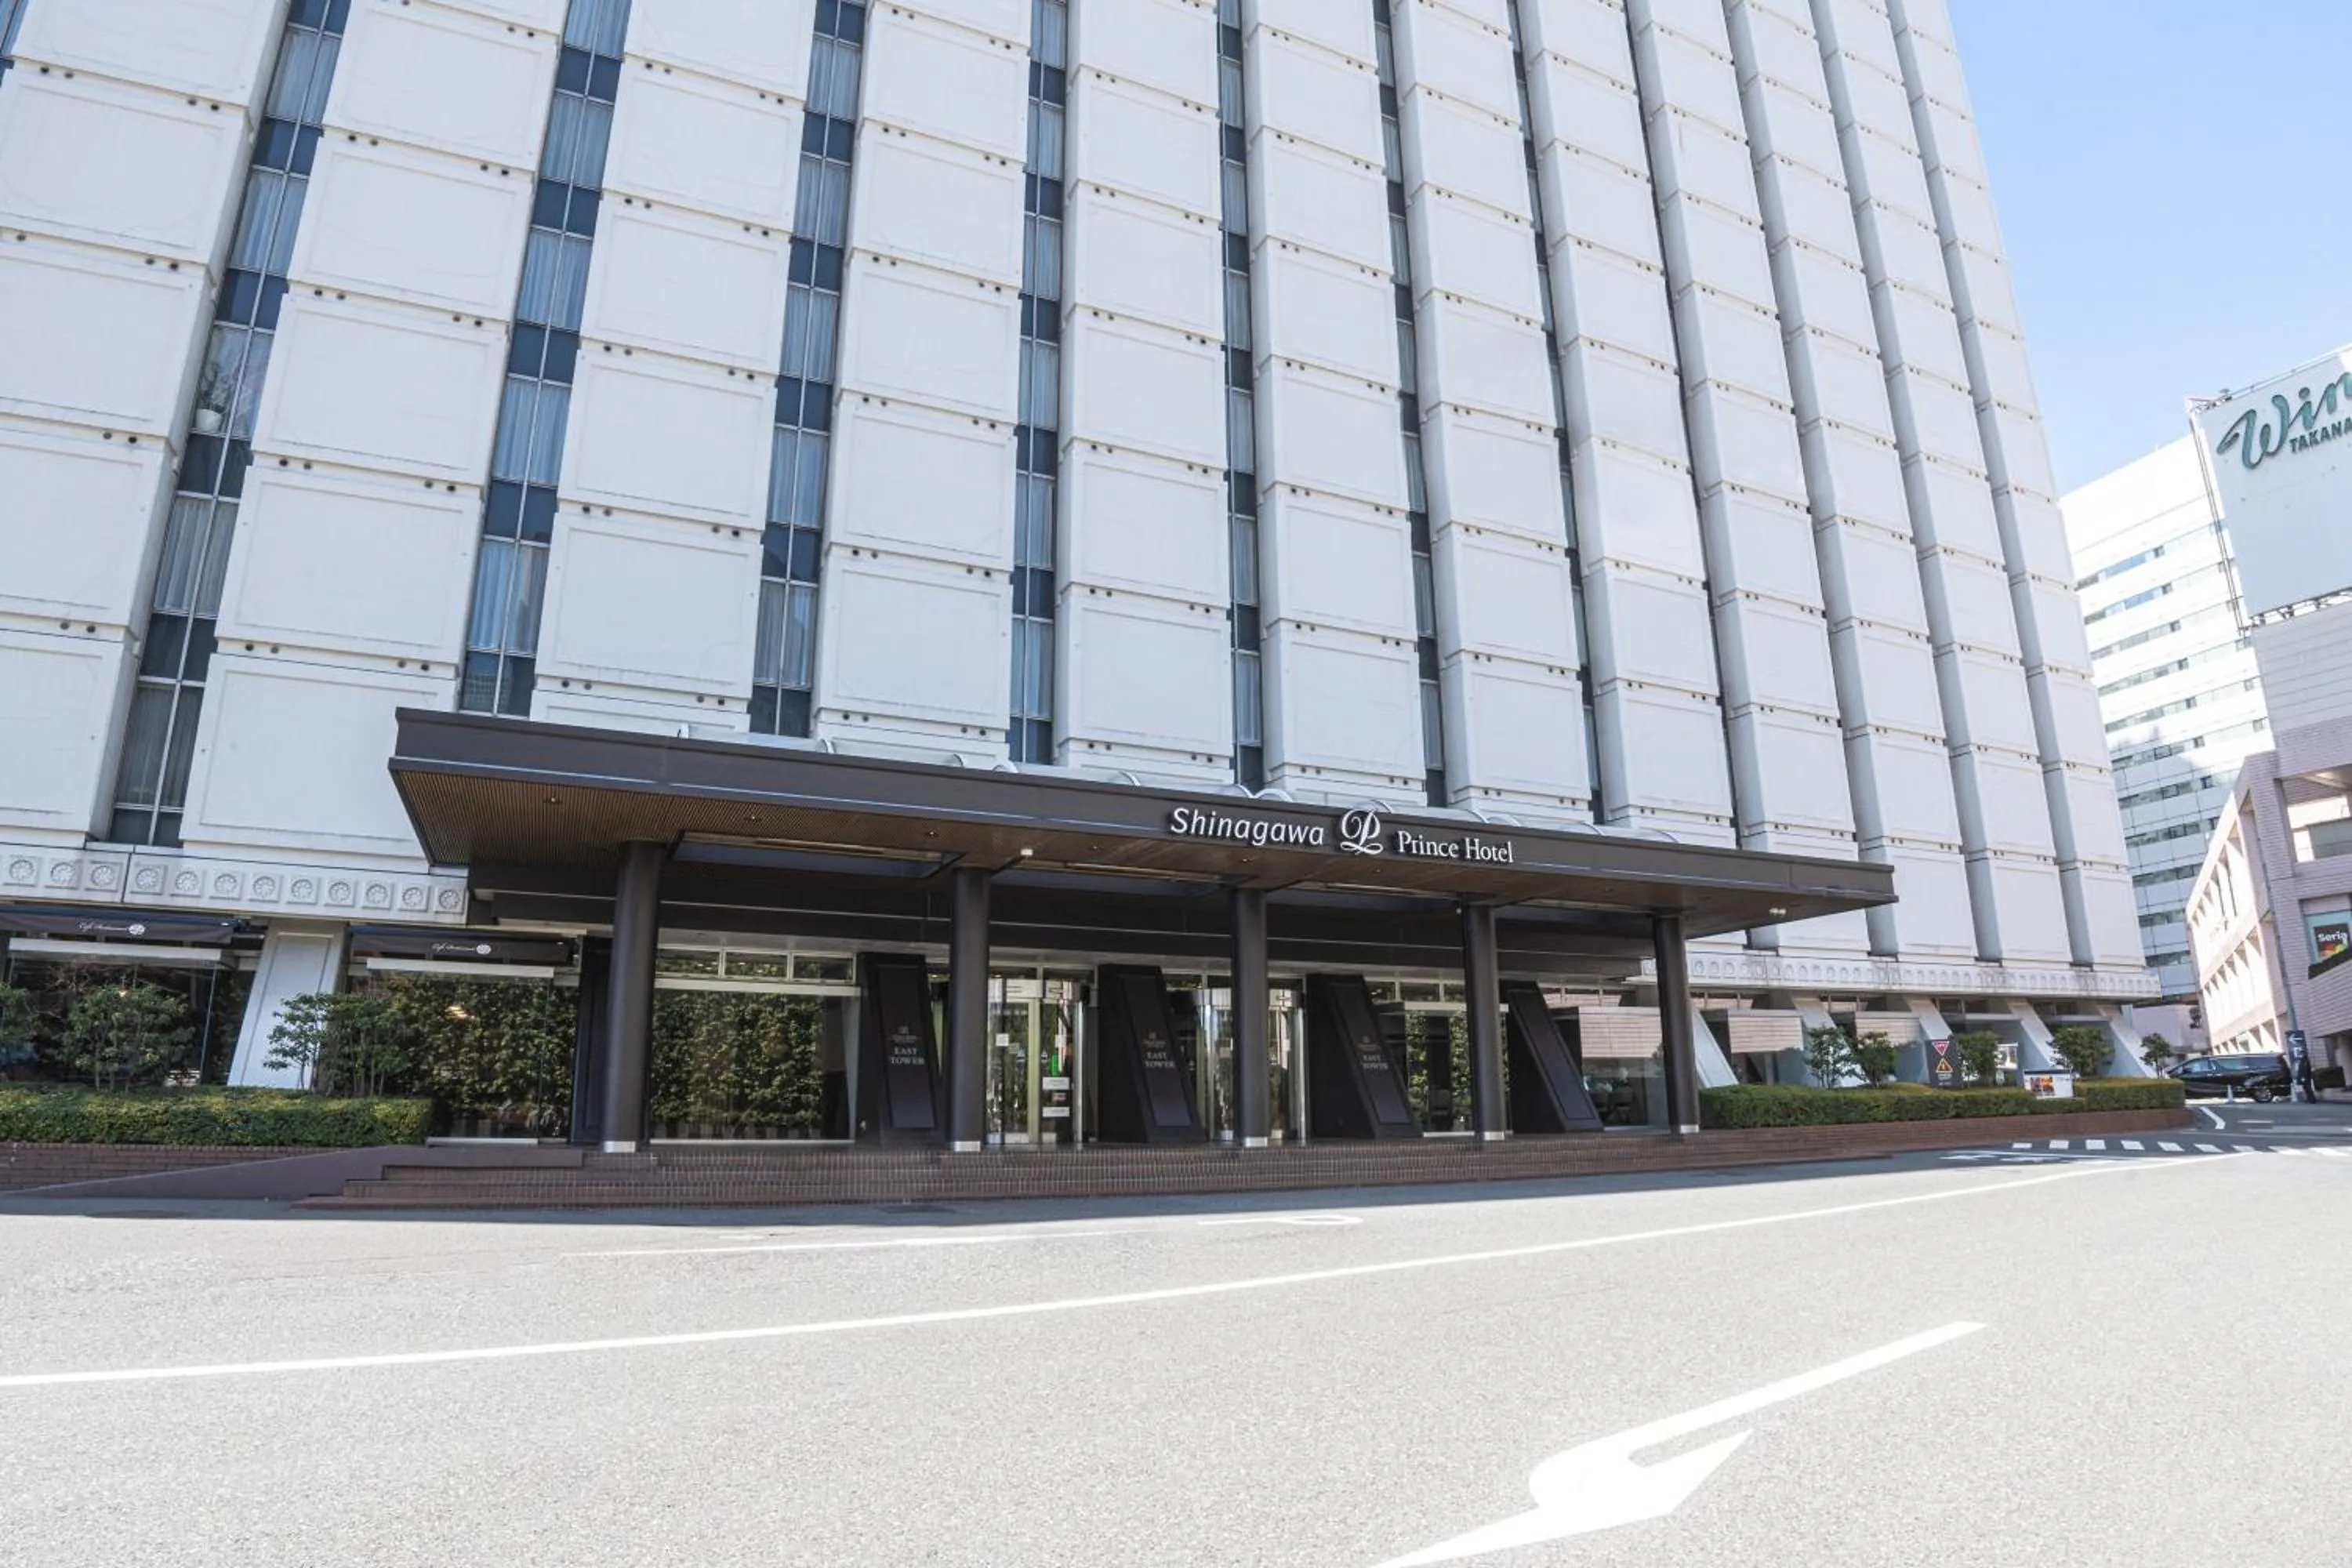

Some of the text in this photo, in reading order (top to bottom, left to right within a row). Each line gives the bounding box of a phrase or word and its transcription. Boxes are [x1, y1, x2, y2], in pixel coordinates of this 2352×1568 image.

[1171, 808, 1324, 846] Shinagawa
[1398, 830, 1459, 858] Prince
[1465, 837, 1514, 863] Hotel
[895, 1046, 916, 1055] EAST
[891, 1056, 925, 1065] TOWER
